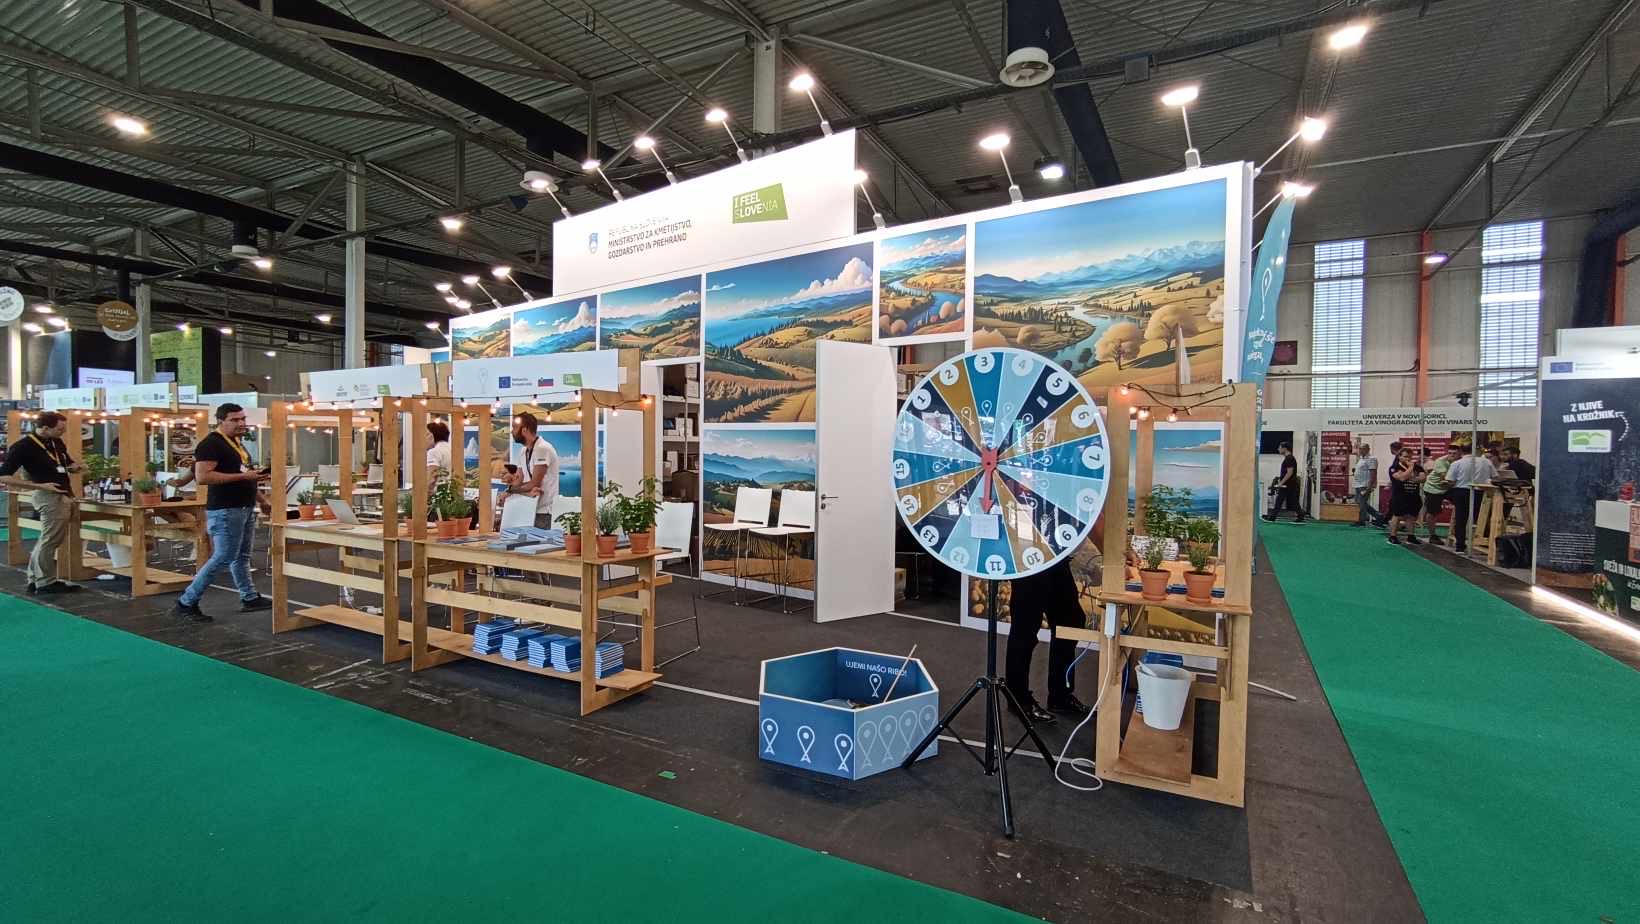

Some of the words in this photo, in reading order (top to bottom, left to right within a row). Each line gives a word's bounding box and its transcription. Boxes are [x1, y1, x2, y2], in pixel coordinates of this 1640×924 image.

[740, 191, 761, 207] FEEL
[735, 199, 778, 218] SLOVENIA
[608, 232, 645, 248] MINISTRSTVO
[645, 229, 654, 239] ZA
[607, 243, 645, 260] GOZDARSTVO
[645, 241, 652, 250] IN
[652, 232, 687, 249] PREHRANO
[981, 356, 989, 368] 3
[944, 369, 954, 381] 2
[1051, 376, 1064, 389] 5
[917, 394, 927, 405] 1
[1569, 403, 1578, 413] Z
[1578, 400, 1604, 411] NJIVE
[1077, 411, 1090, 421] 6
[1361, 413, 1397, 421] UNIVERZA
[1562, 414, 1577, 424] NA
[1576, 409, 1616, 422] KROŽNIK
[1089, 453, 1101, 463] 7
[895, 463, 906, 476] 15
[902, 498, 917, 513] 14
[1082, 494, 1095, 506] 8
[922, 529, 938, 544] 13
[1026, 551, 1042, 567] 10
[990, 560, 1003, 573] 11
[845, 659, 867, 671] UJEMI
[866, 662, 887, 673] NAŠO
